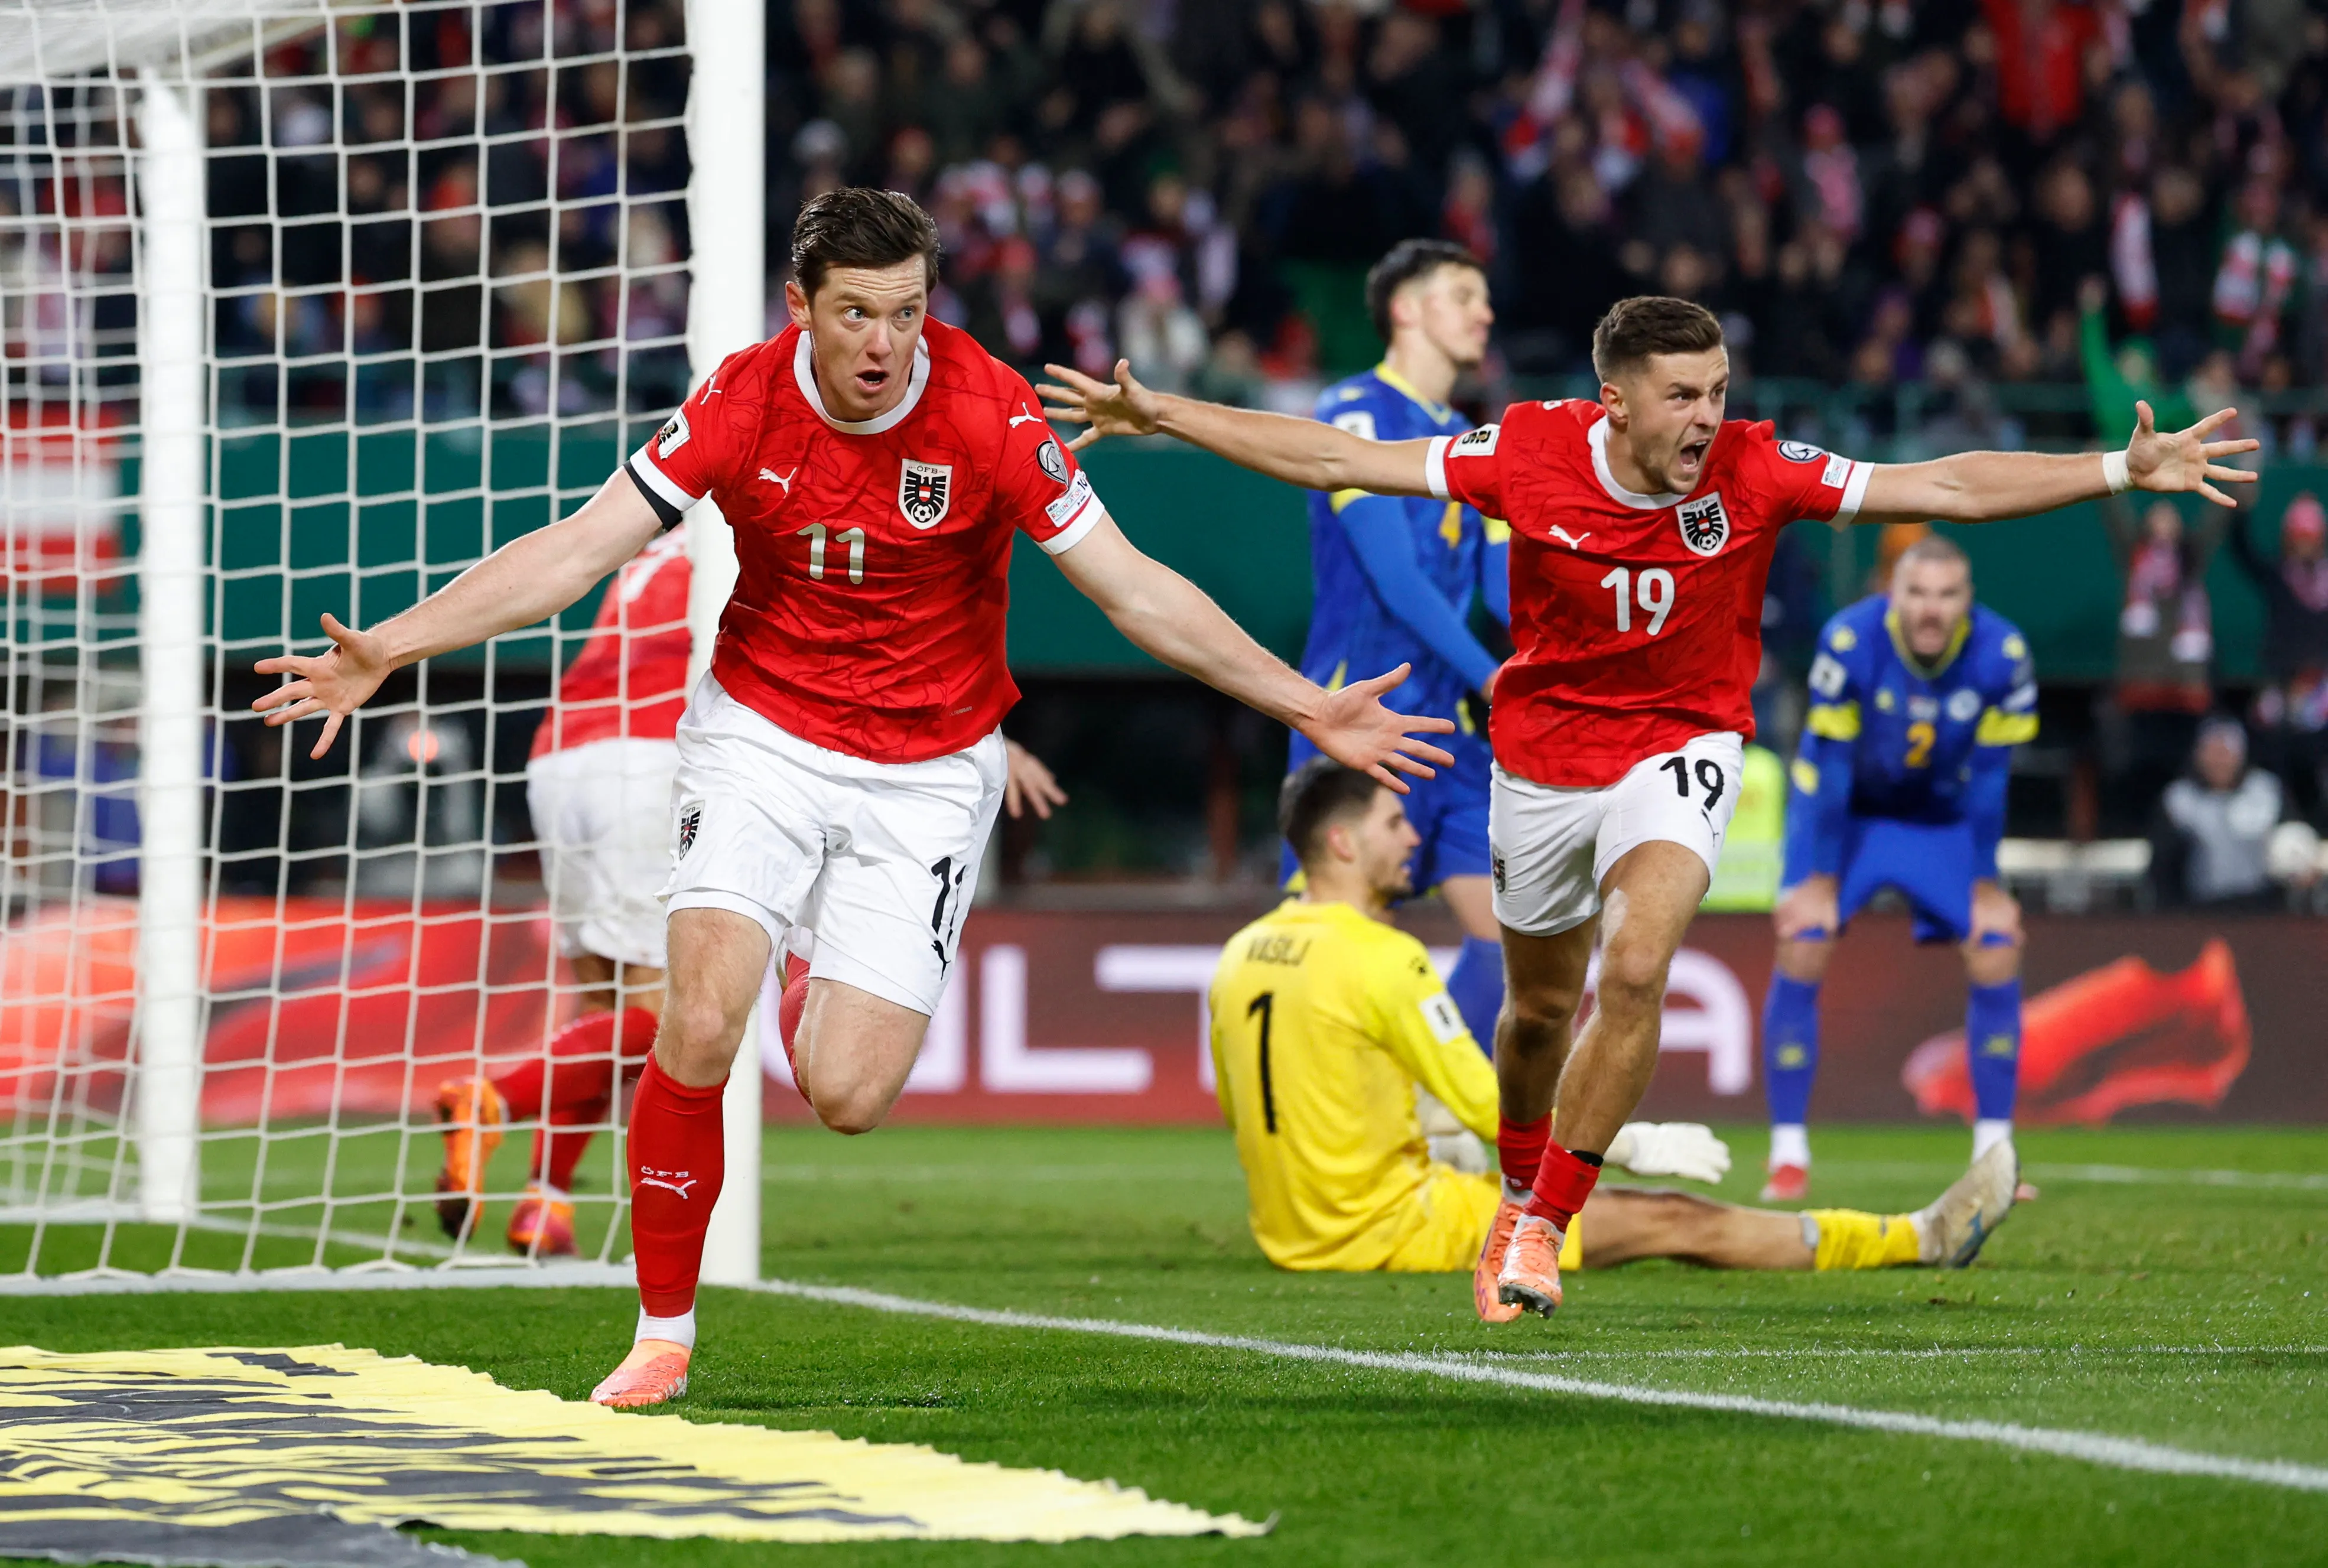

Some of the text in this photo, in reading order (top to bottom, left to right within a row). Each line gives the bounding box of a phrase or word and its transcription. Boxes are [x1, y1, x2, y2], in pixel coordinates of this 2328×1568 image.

[796, 523, 864, 585] 11
[1601, 567, 1675, 636] 19
[1905, 720, 1936, 768] 2
[1660, 756, 1724, 811] 19
[1247, 991, 1275, 1133] 1
[641, 1166, 689, 1178] ÖFB
